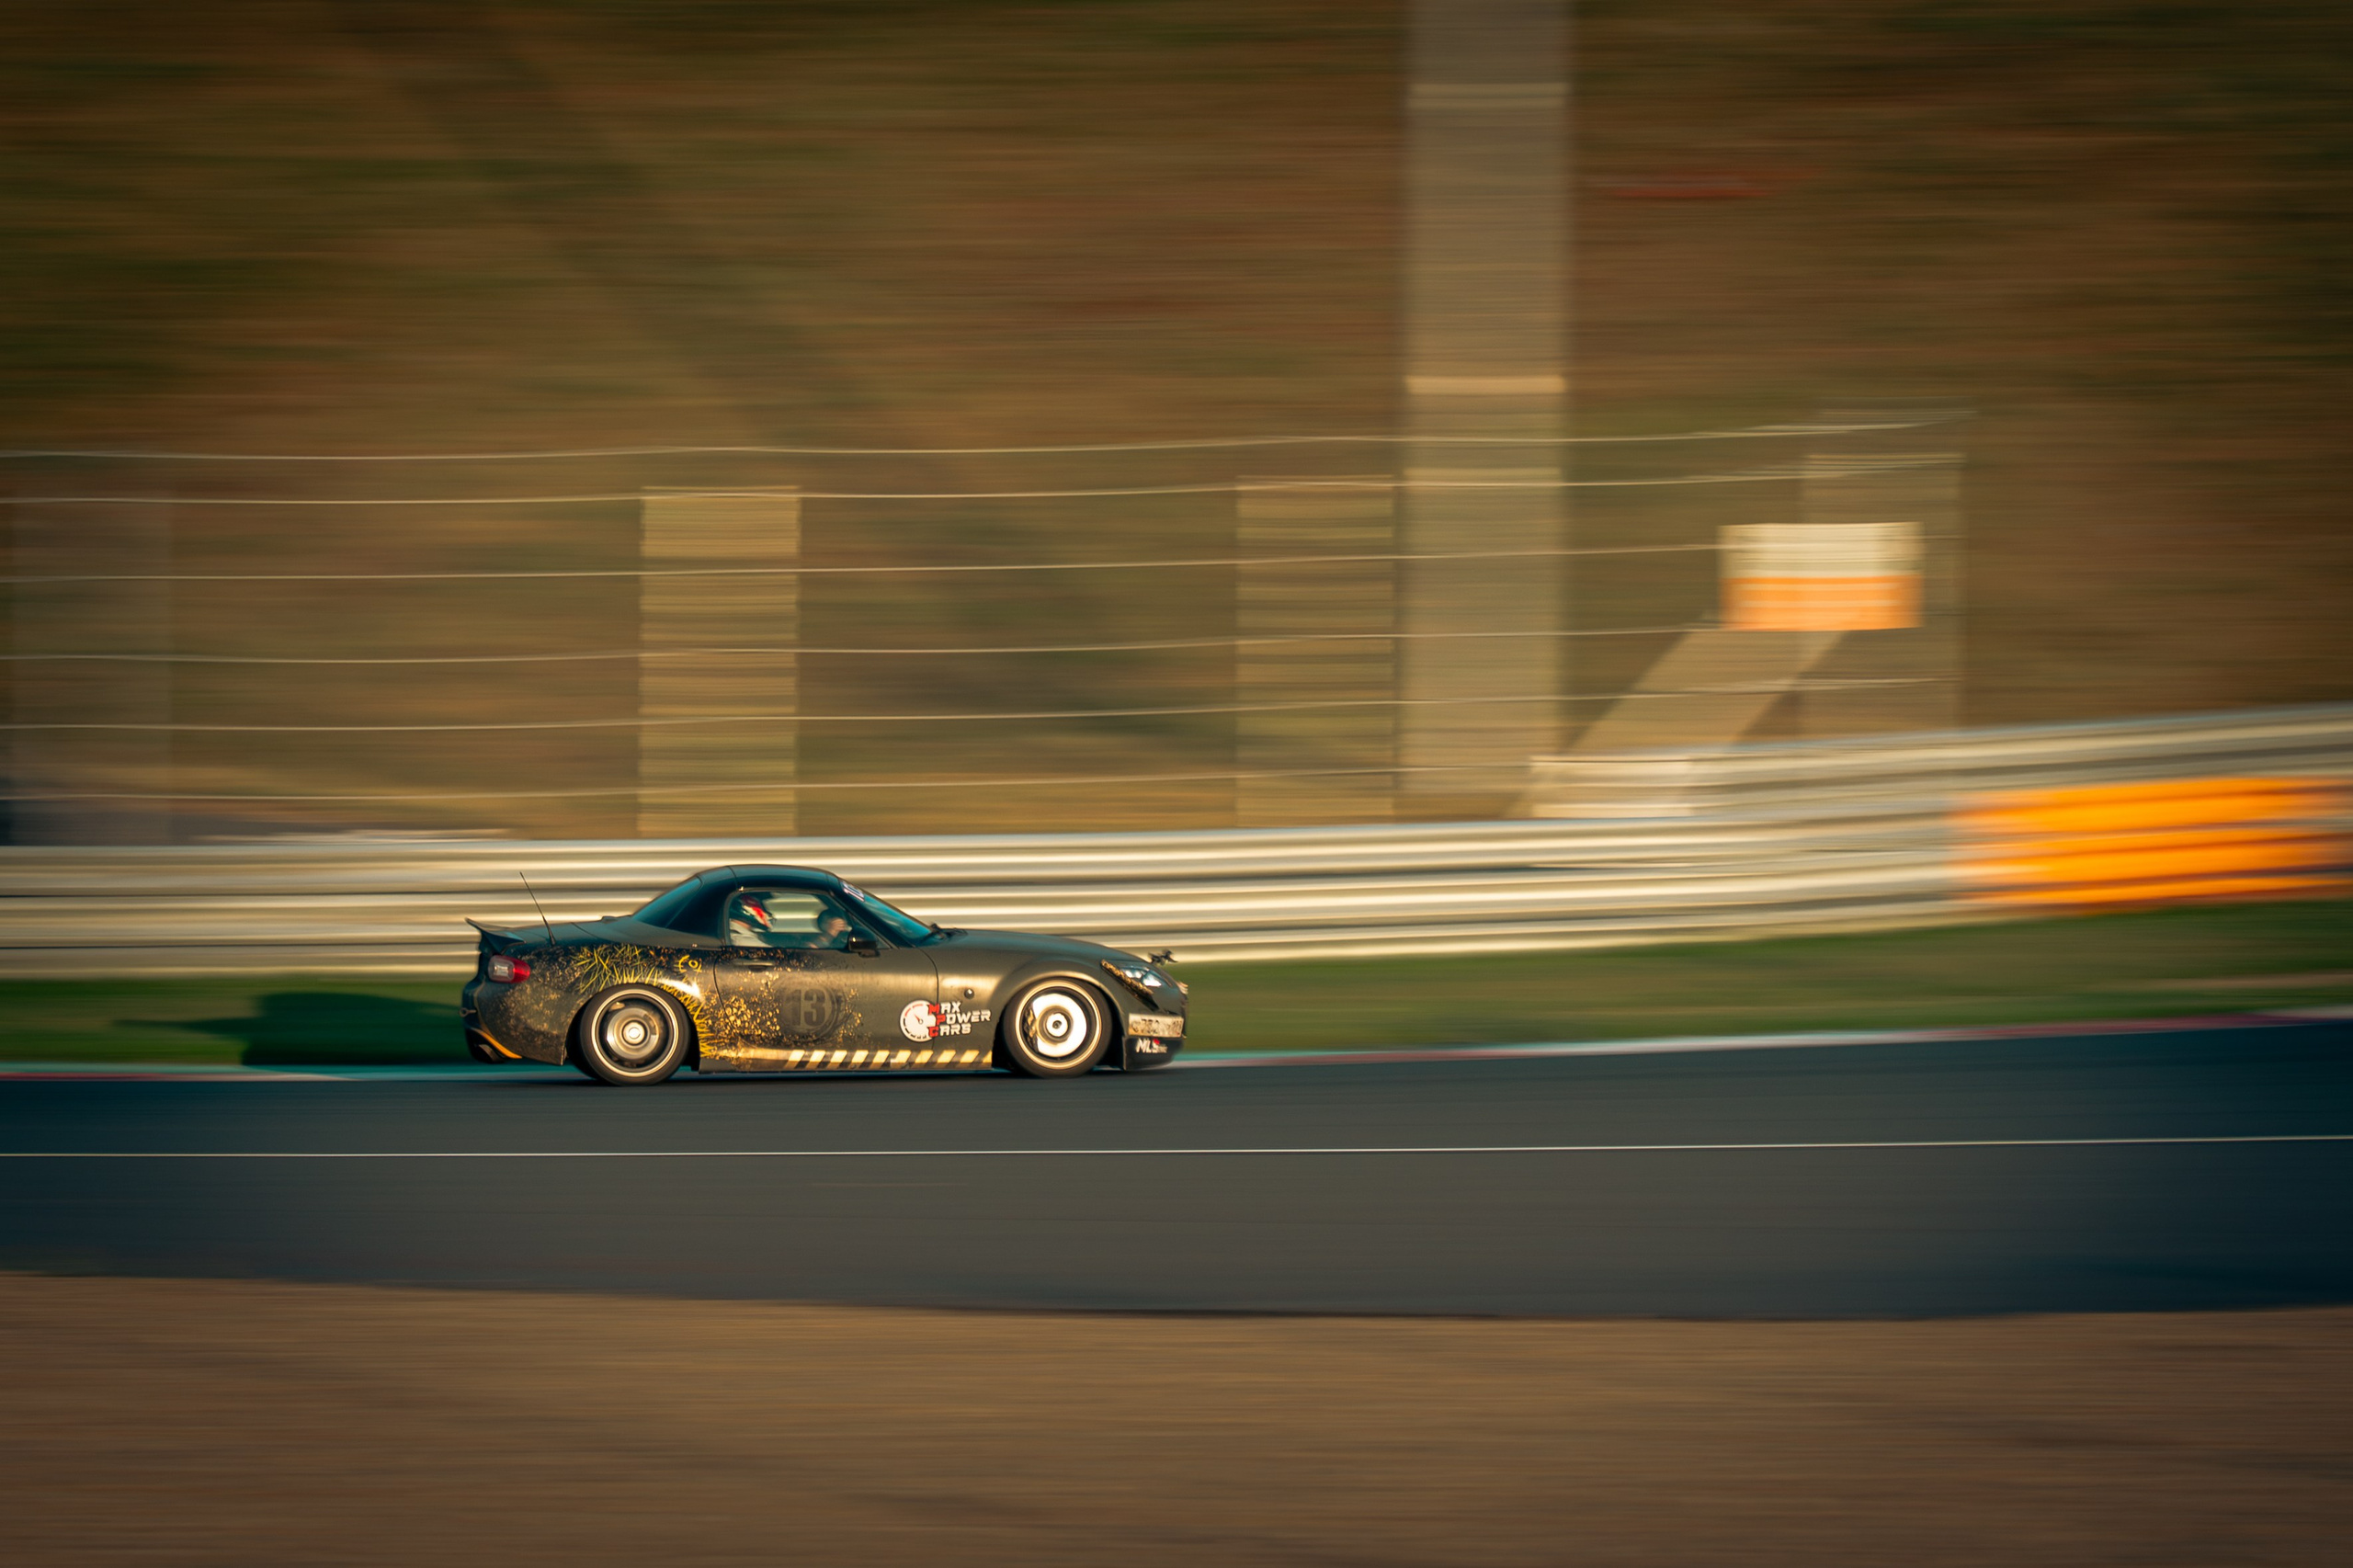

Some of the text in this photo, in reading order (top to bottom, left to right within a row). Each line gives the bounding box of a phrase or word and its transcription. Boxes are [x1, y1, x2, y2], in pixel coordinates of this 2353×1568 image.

[790, 988, 826, 1026] 13
[928, 1001, 961, 1016] MAX
[936, 1009, 991, 1025] POWER
[928, 1023, 972, 1037] CARS
